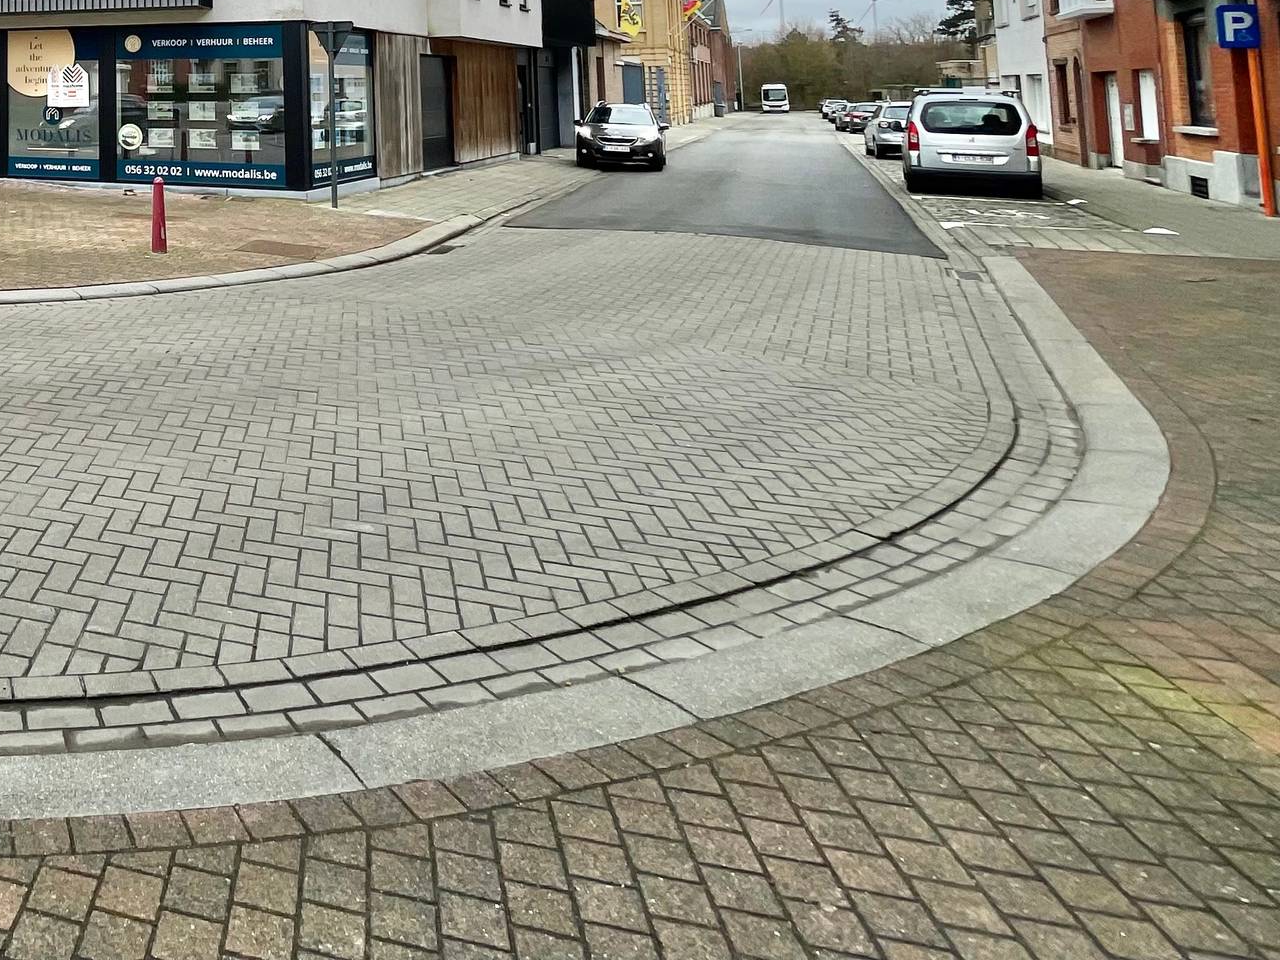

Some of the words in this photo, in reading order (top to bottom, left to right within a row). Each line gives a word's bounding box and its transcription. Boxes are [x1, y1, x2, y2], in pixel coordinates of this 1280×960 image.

[1223, 12, 1253, 41] P
[29, 41, 43, 50] Let
[151, 39, 187, 47] VERKOOP
[196, 38, 233, 46] VERHUUR
[243, 37, 274, 45] BEHEER
[29, 53, 43, 61] the
[15, 64, 52, 72] adventur
[15, 128, 92, 142] MODALIS
[125, 165, 142, 175] 056
[143, 166, 156, 175] 32
[156, 166, 169, 175] 02
[170, 166, 183, 176] 02
[194, 168, 278, 180] www.modalis.be
